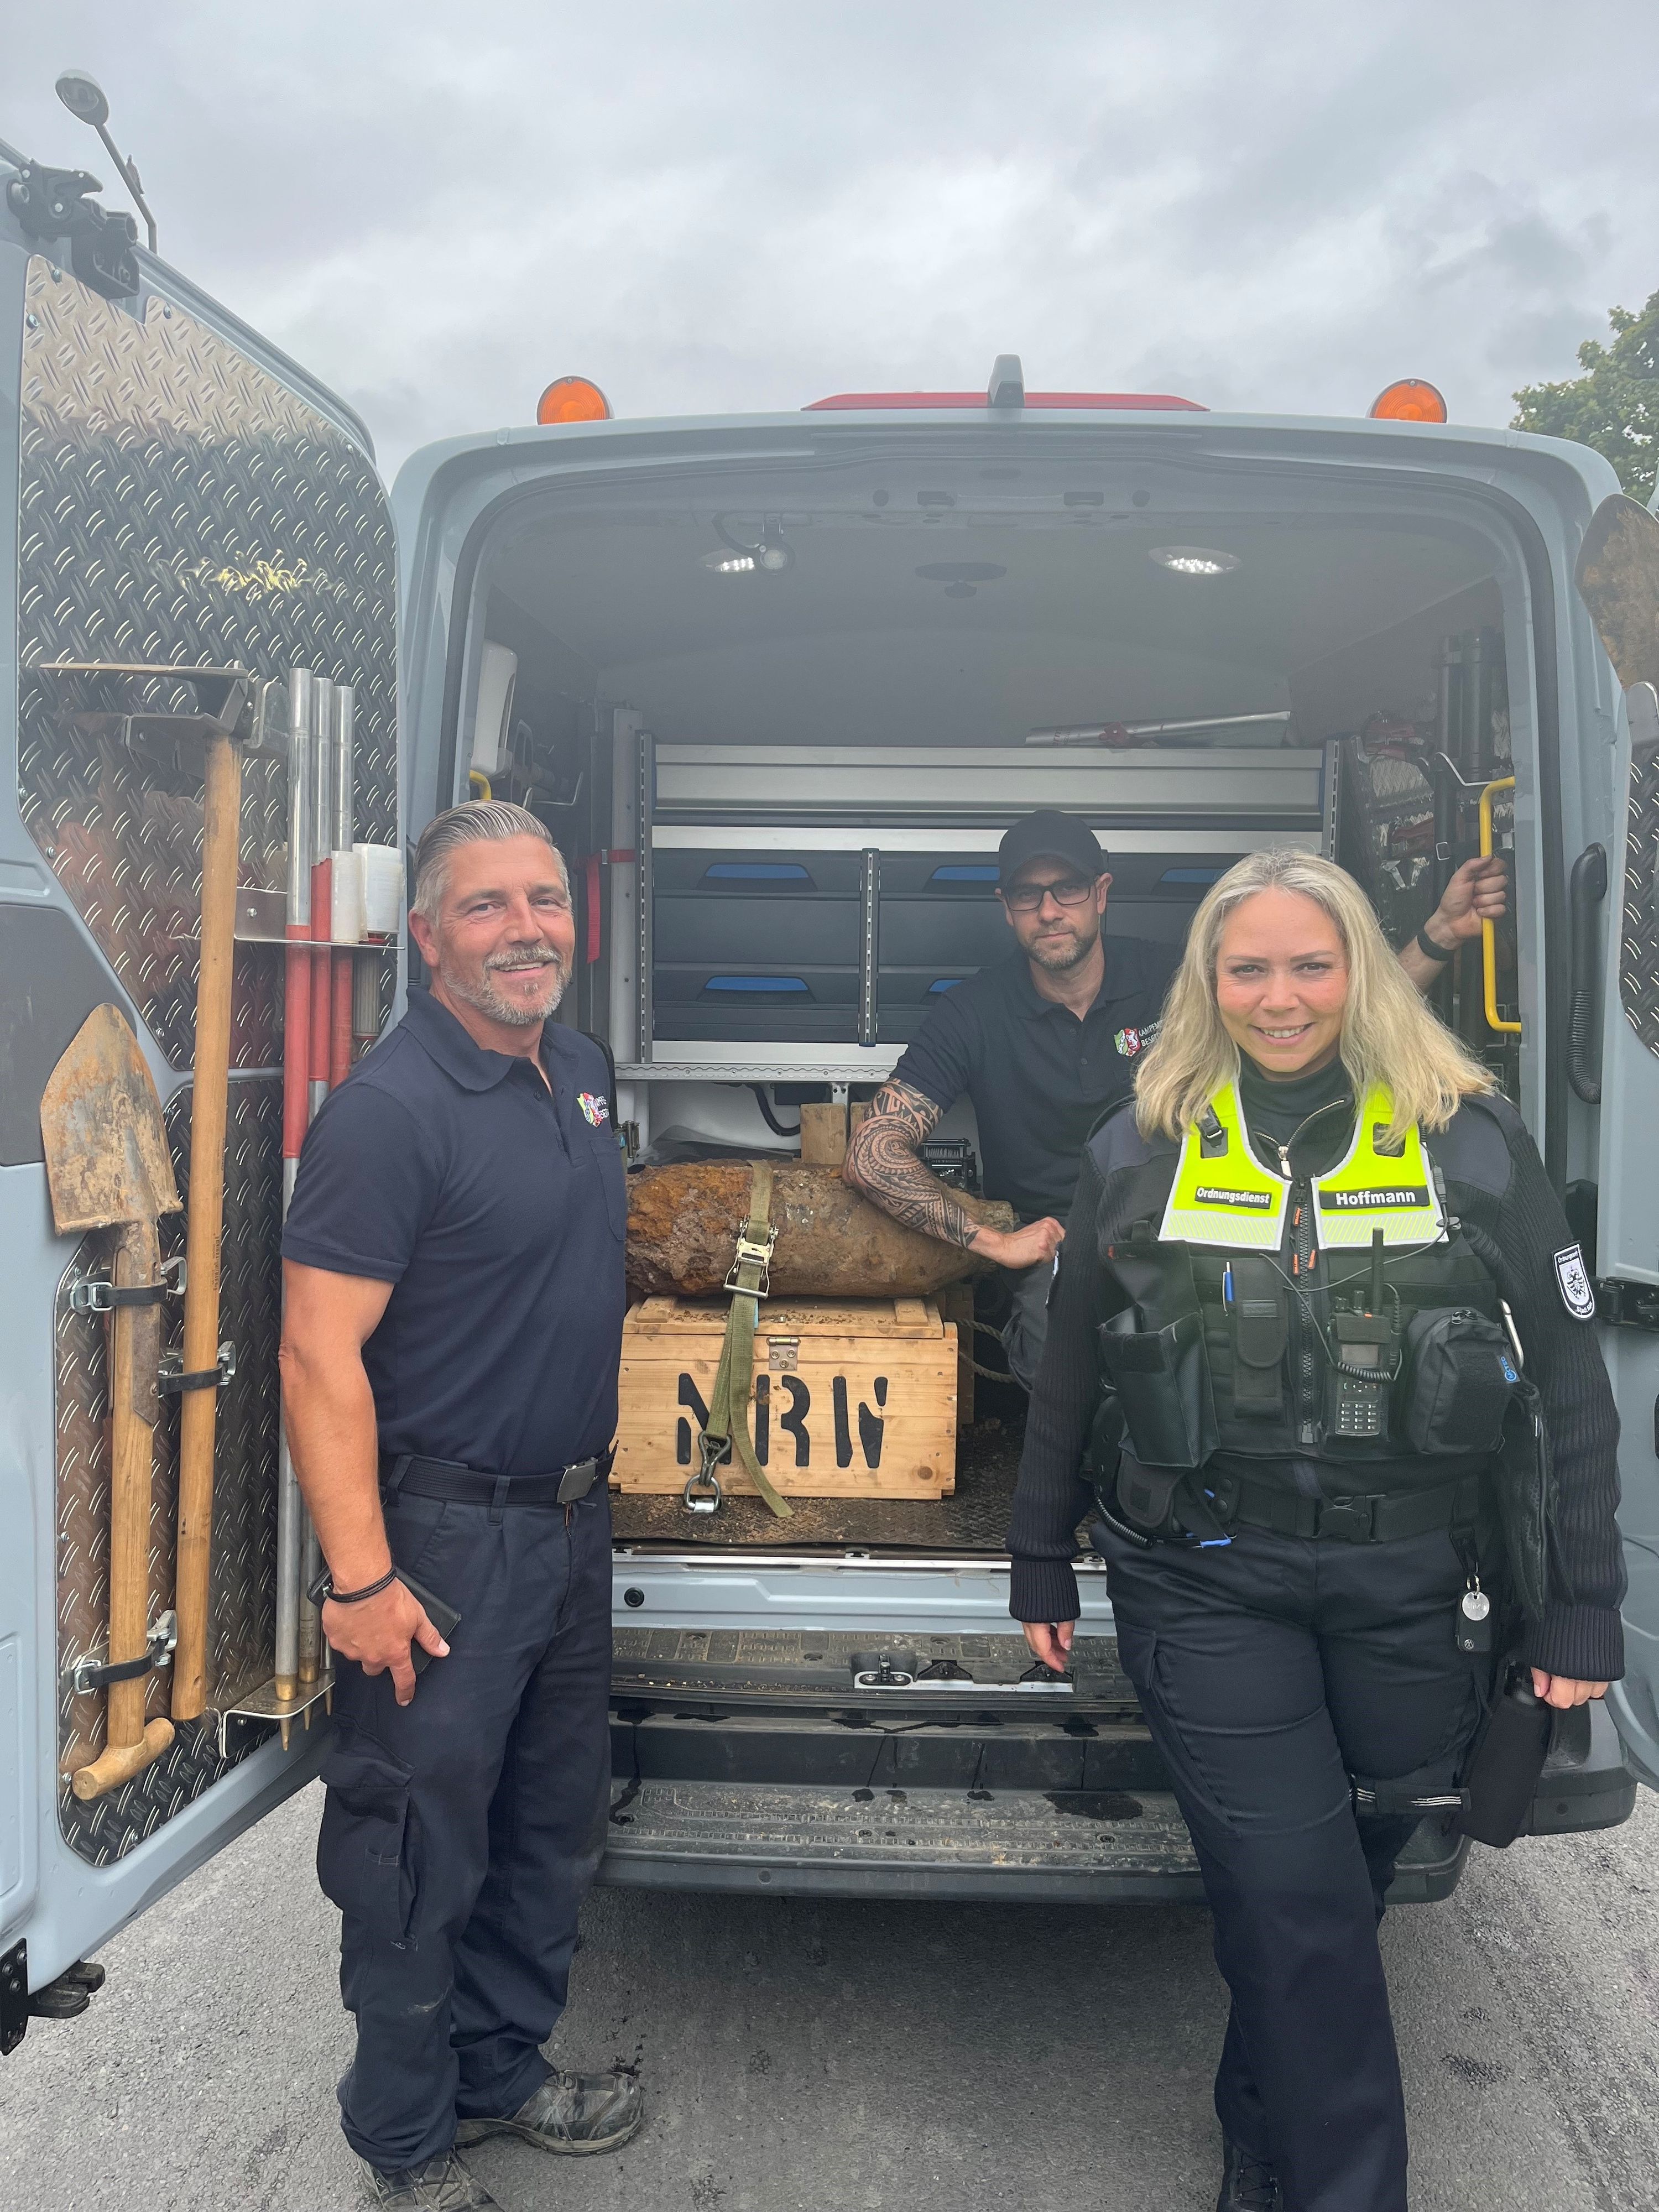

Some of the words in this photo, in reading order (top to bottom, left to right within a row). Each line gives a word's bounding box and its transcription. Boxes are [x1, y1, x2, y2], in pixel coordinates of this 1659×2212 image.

[1197, 1187, 1270, 1204] Ordnungsdienst
[1335, 1190, 1416, 1206] Hoffmann
[677, 1373, 888, 1469] NRW
